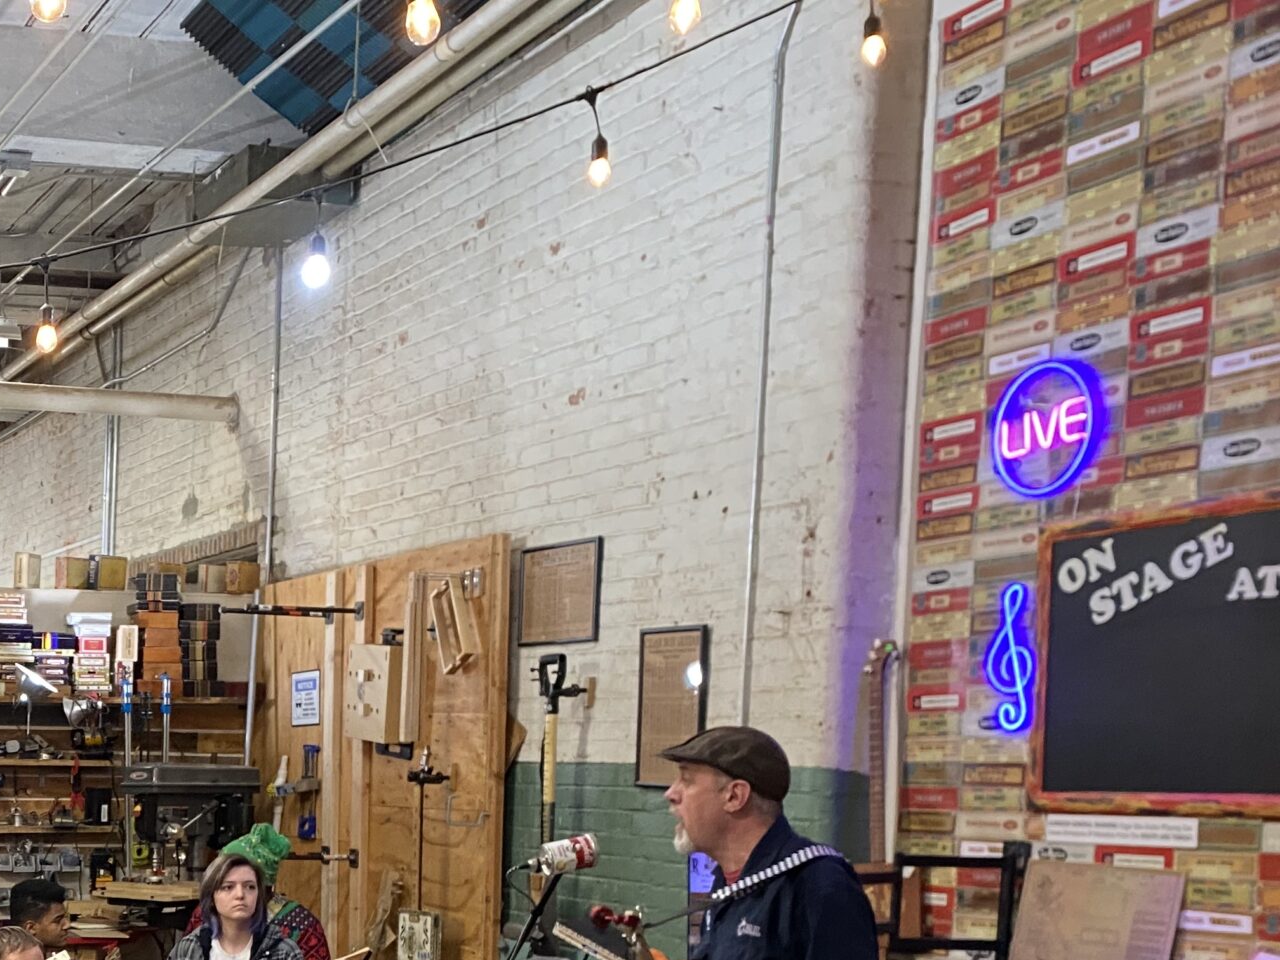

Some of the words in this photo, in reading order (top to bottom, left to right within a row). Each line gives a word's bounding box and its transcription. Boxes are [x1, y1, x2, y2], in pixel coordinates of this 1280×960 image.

[1001, 396, 1087, 460] LIVE
[1057, 538, 1117, 593] ON
[1089, 523, 1235, 625] STAGE
